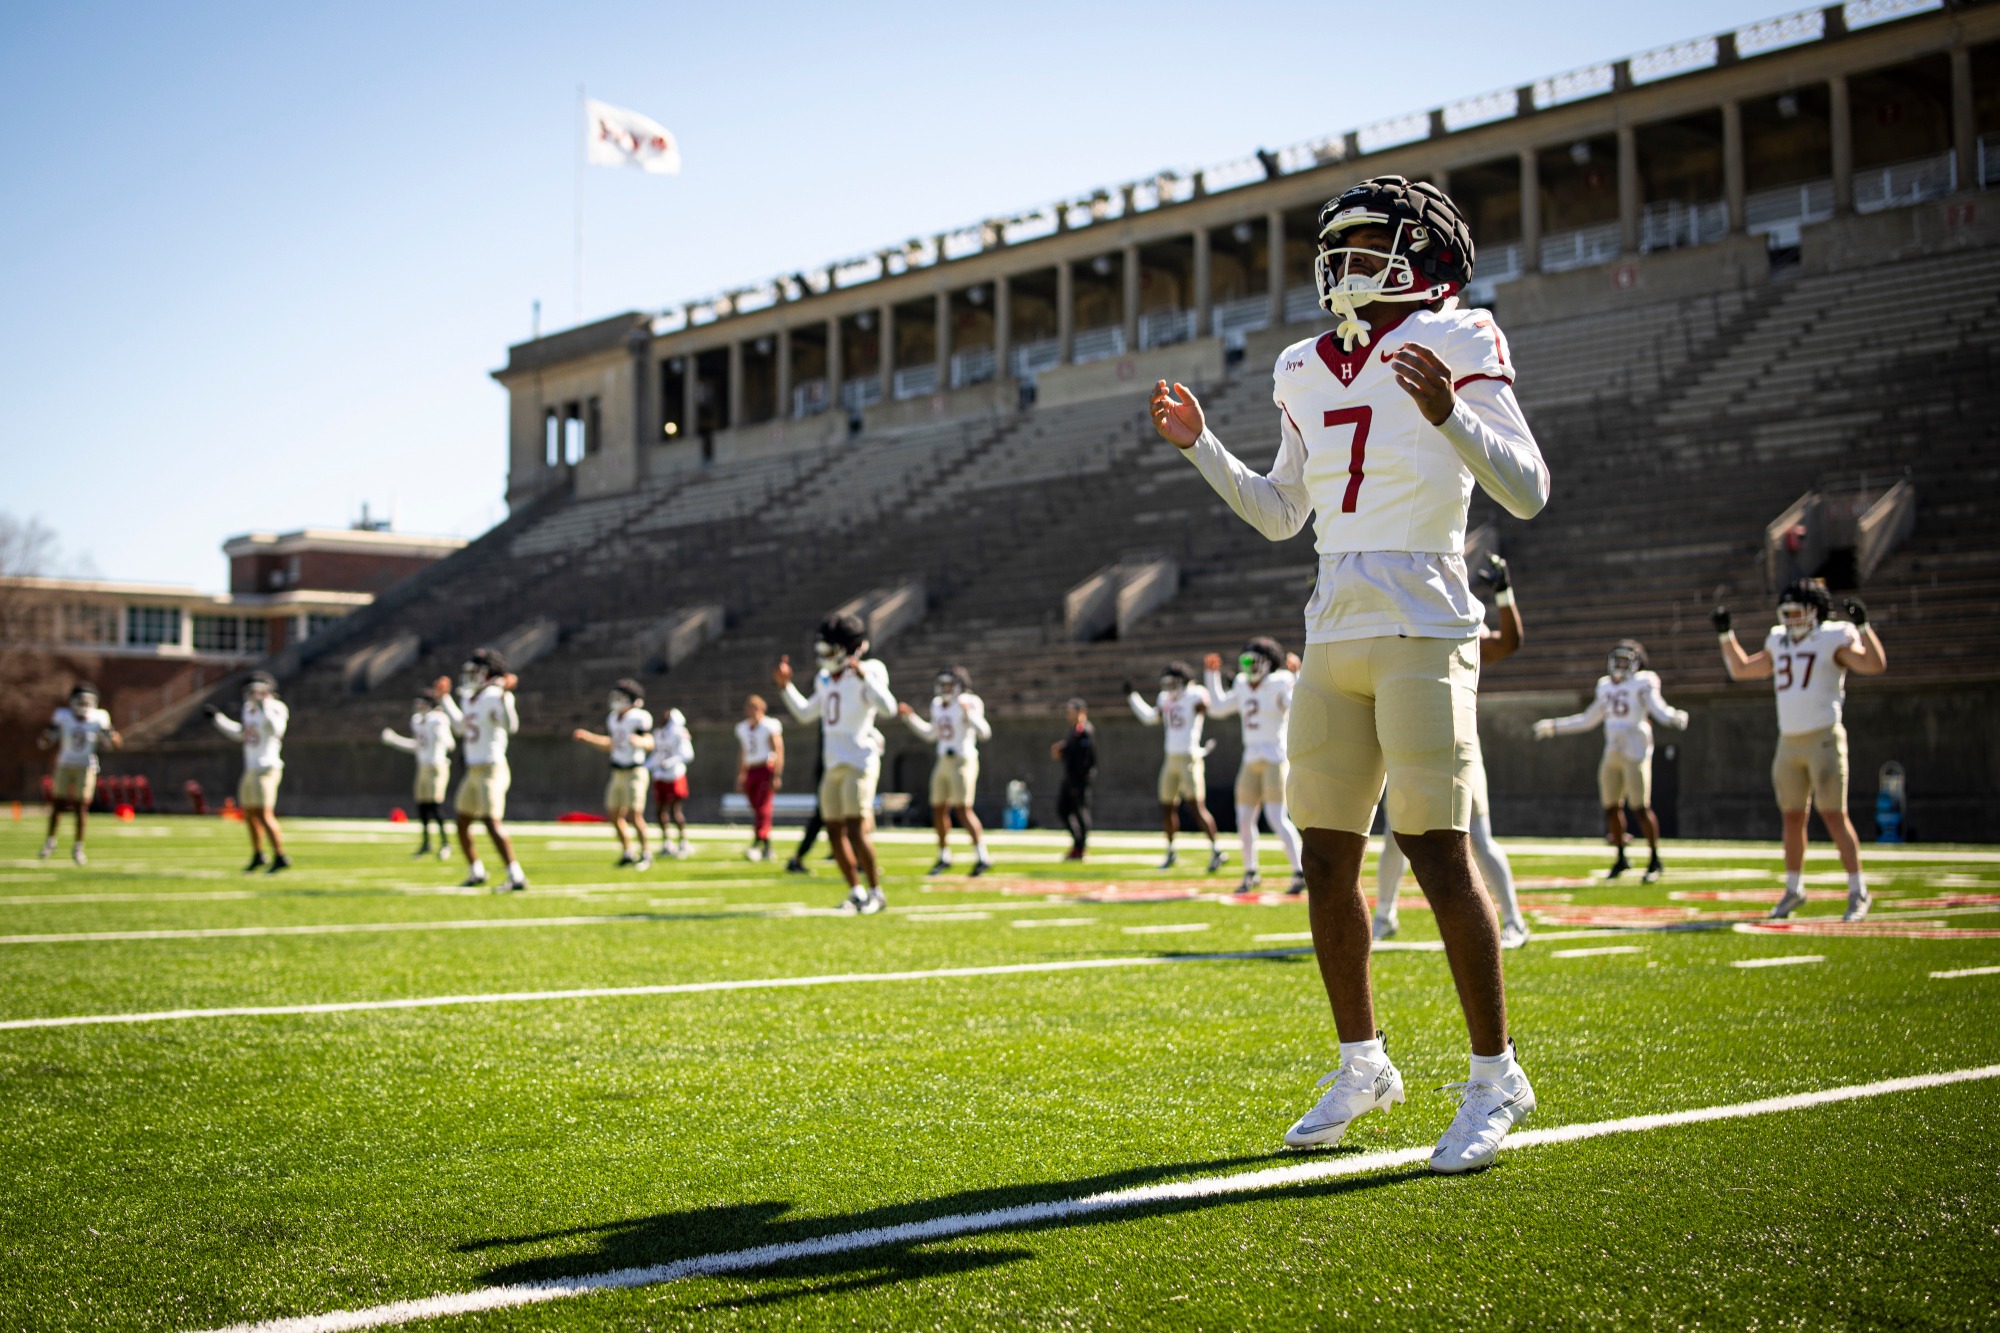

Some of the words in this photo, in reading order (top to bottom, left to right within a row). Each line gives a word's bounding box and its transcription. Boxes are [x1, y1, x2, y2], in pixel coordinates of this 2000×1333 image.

[1341, 362, 1353, 379] H
[1323, 405, 1372, 513] 7
[1776, 652, 1816, 691] 37
[827, 692, 841, 725] 0
[1244, 698, 1261, 730] 2
